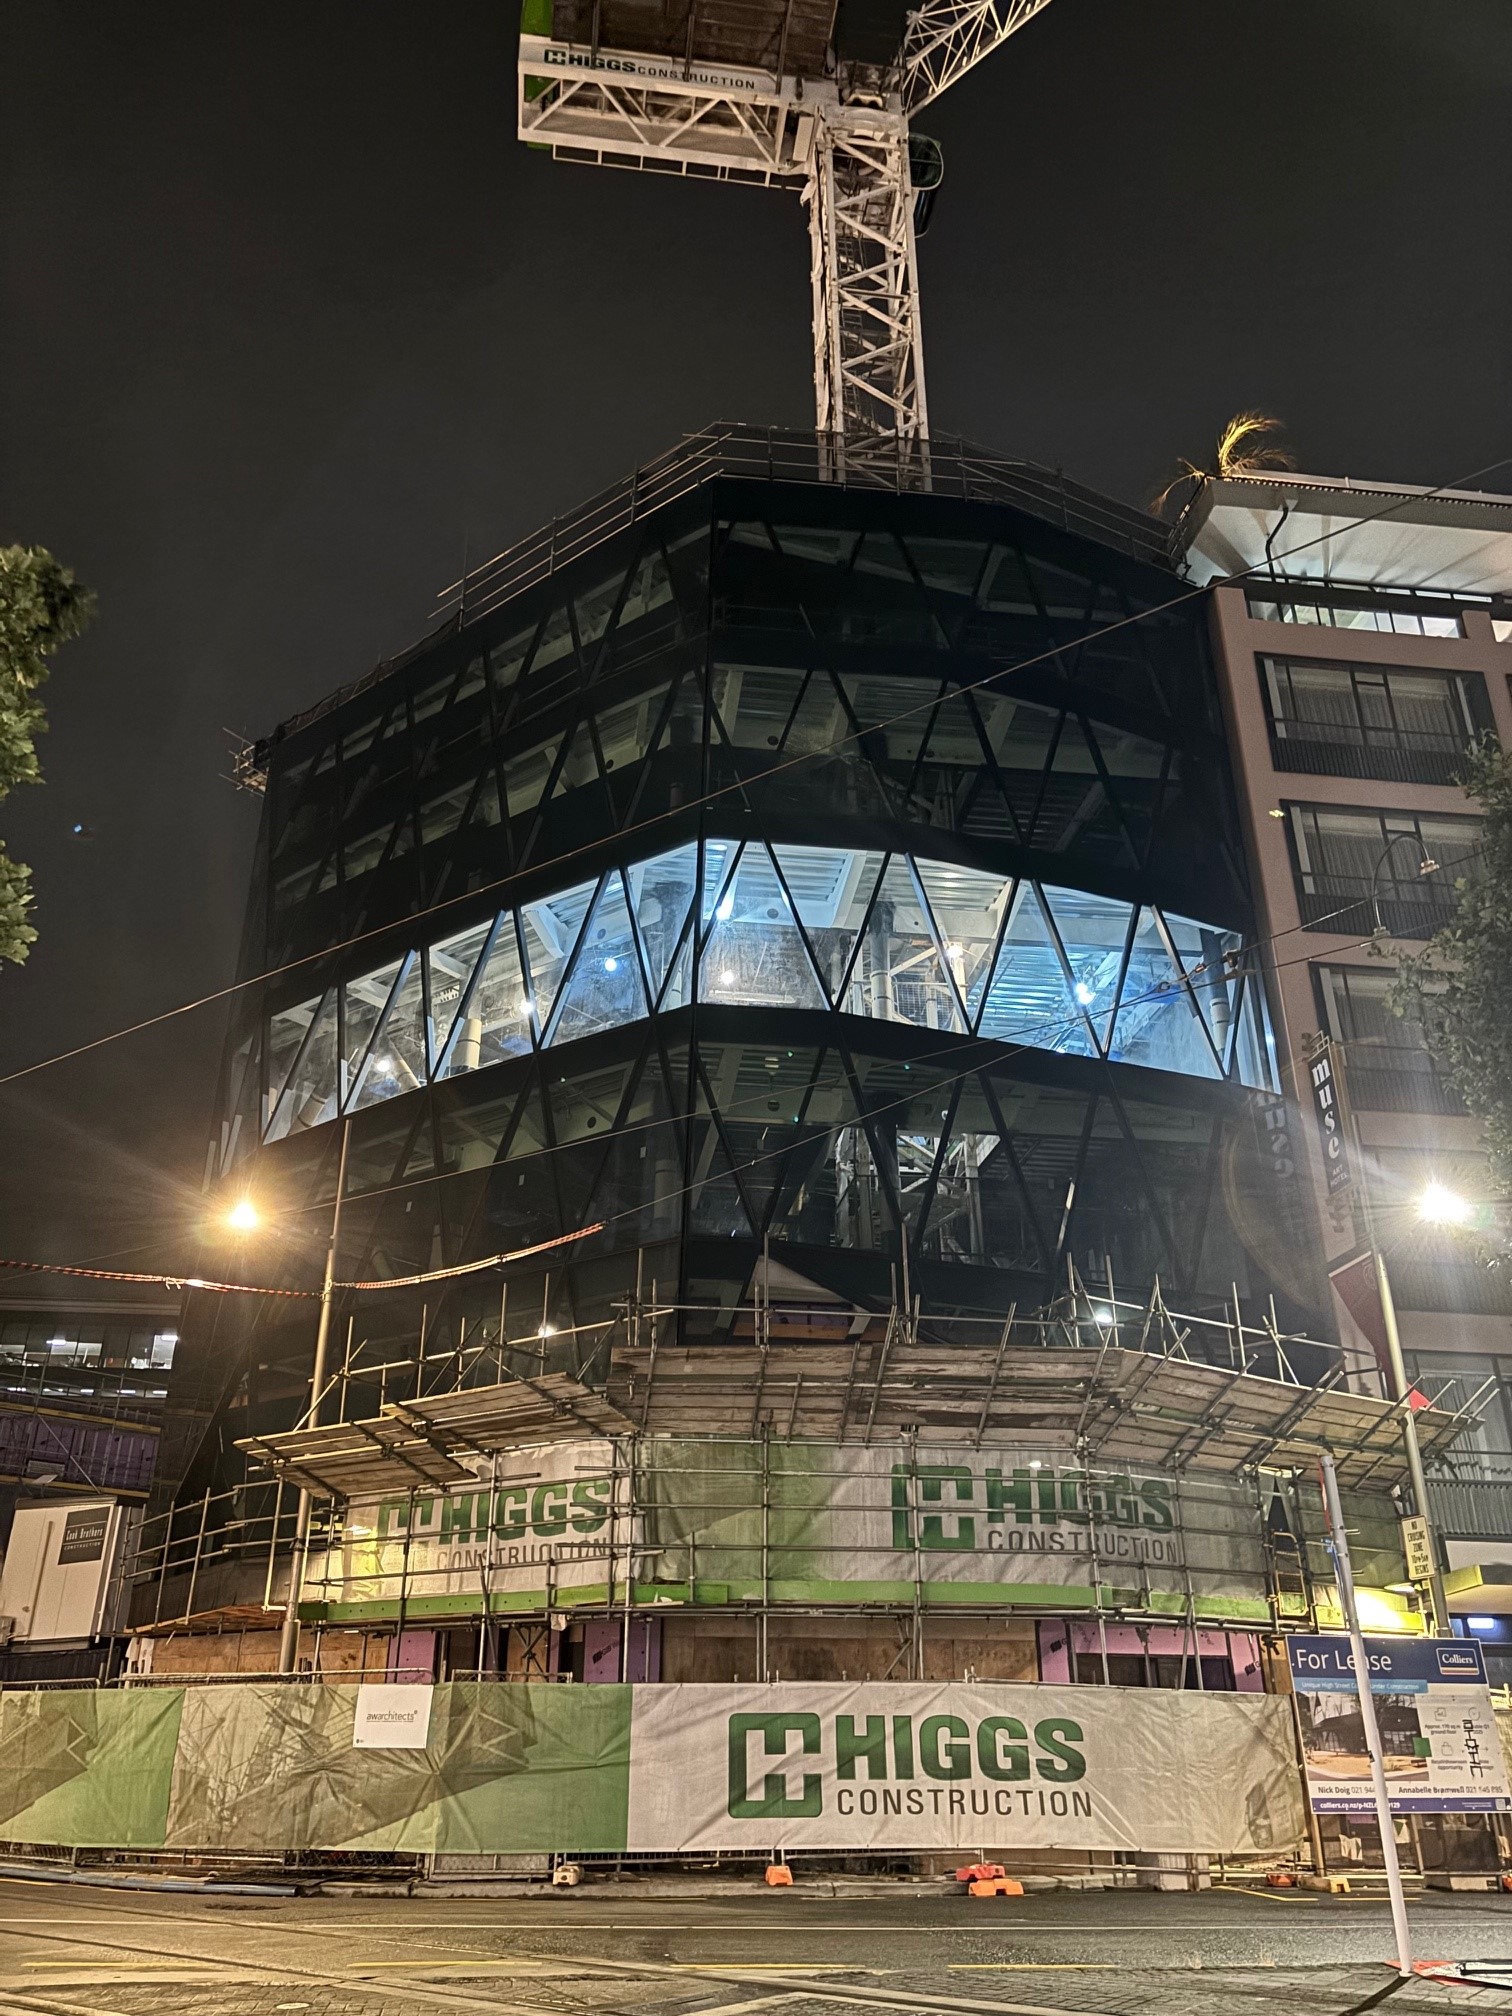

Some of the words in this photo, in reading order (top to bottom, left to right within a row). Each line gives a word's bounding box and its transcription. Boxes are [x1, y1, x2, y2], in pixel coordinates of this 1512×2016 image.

[569, 54, 636, 73] HIGGS
[1312, 1058, 1340, 1160] muse
[1330, 1172, 1348, 1186] HOTEL
[1332, 1164, 1343, 1176] ART
[438, 1480, 611, 1545] HIGGS
[985, 1468, 1173, 1534] HIGGS
[987, 1530, 1177, 1563] CONSTRUCTION
[1296, 1649, 1329, 1669] For
[1443, 1654, 1473, 1664] Colliers
[835, 1714, 1086, 1783] HIGGS
[836, 1788, 1092, 1817] CONSTRUCTION
[1335, 1787, 1350, 1795] Doig
